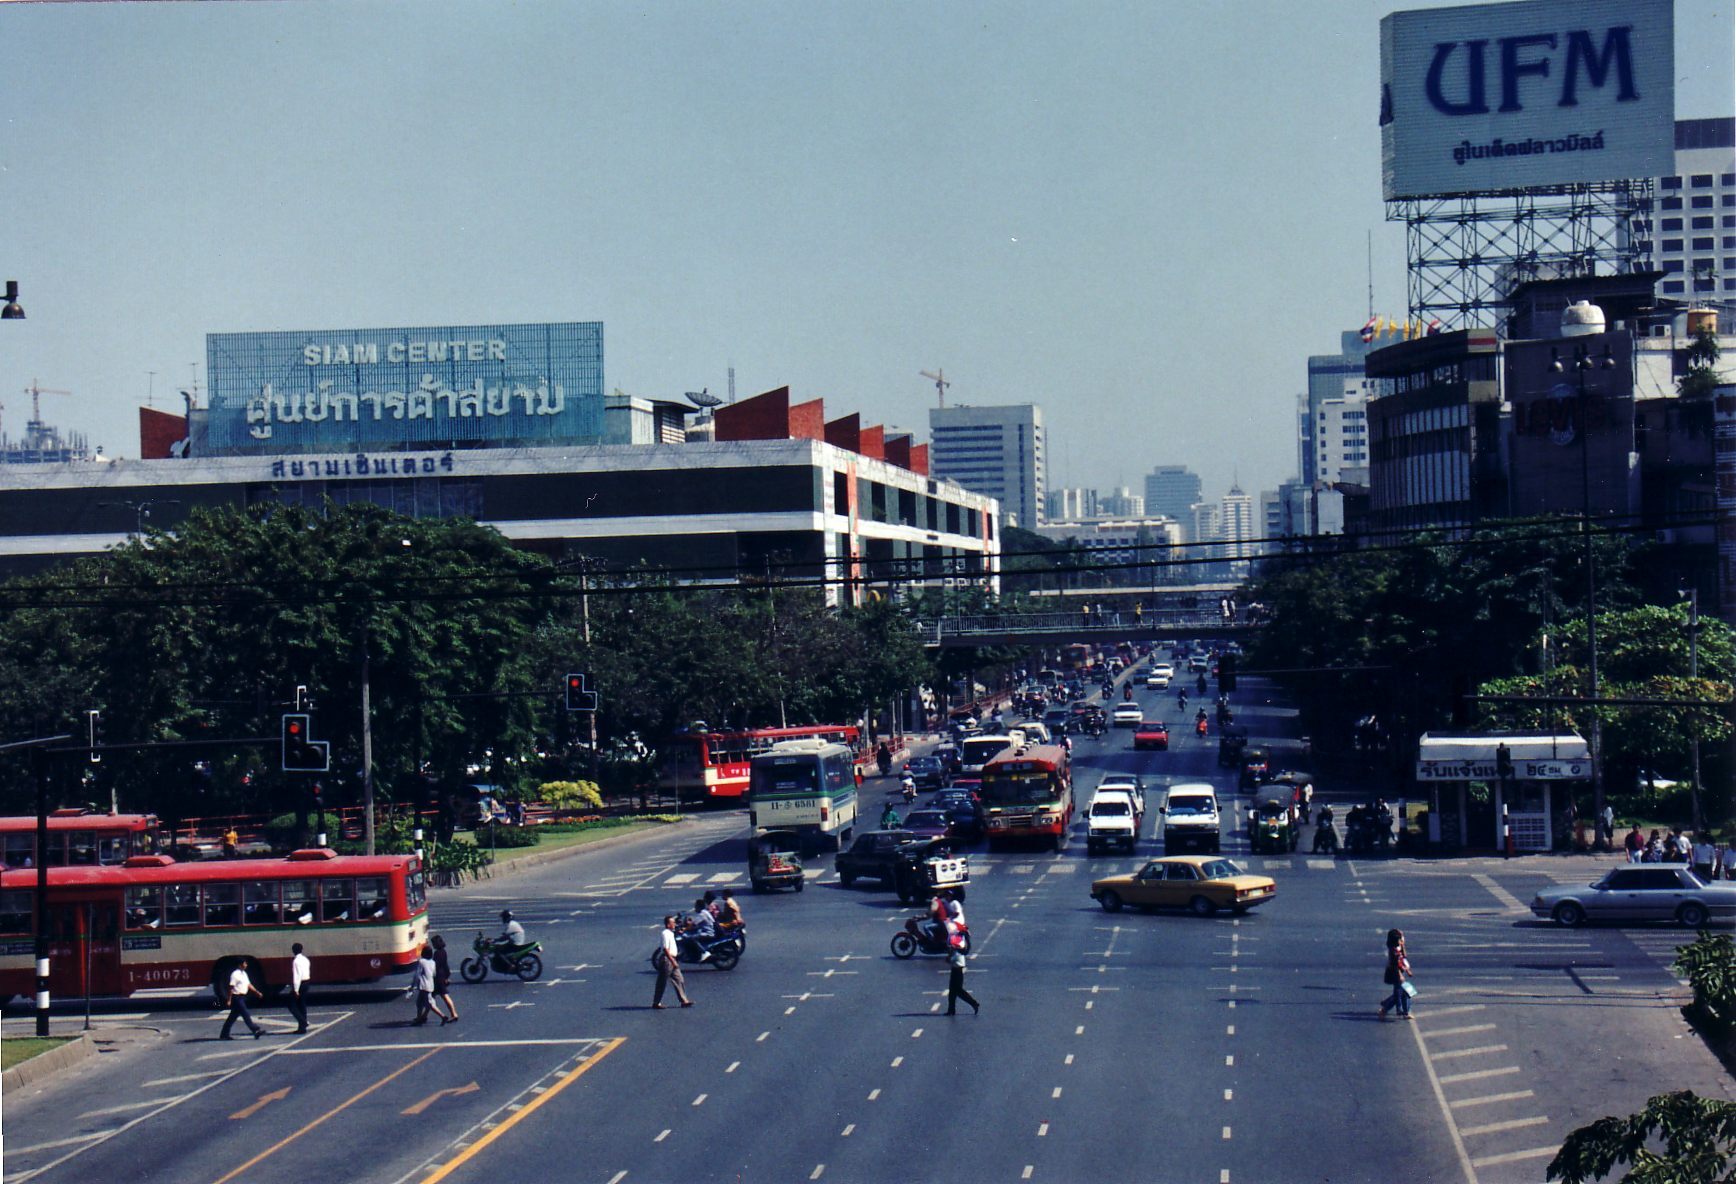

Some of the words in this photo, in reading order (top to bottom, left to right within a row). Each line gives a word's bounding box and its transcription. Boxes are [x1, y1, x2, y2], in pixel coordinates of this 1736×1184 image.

[1425, 25, 1641, 116] UFM
[303, 343, 377, 366] SIAM
[387, 340, 506, 363] CENTER
[246, 373, 565, 439] ศูนย์การค้าสยาม
[271, 452, 453, 478] สยามเซ็นเตอร์
